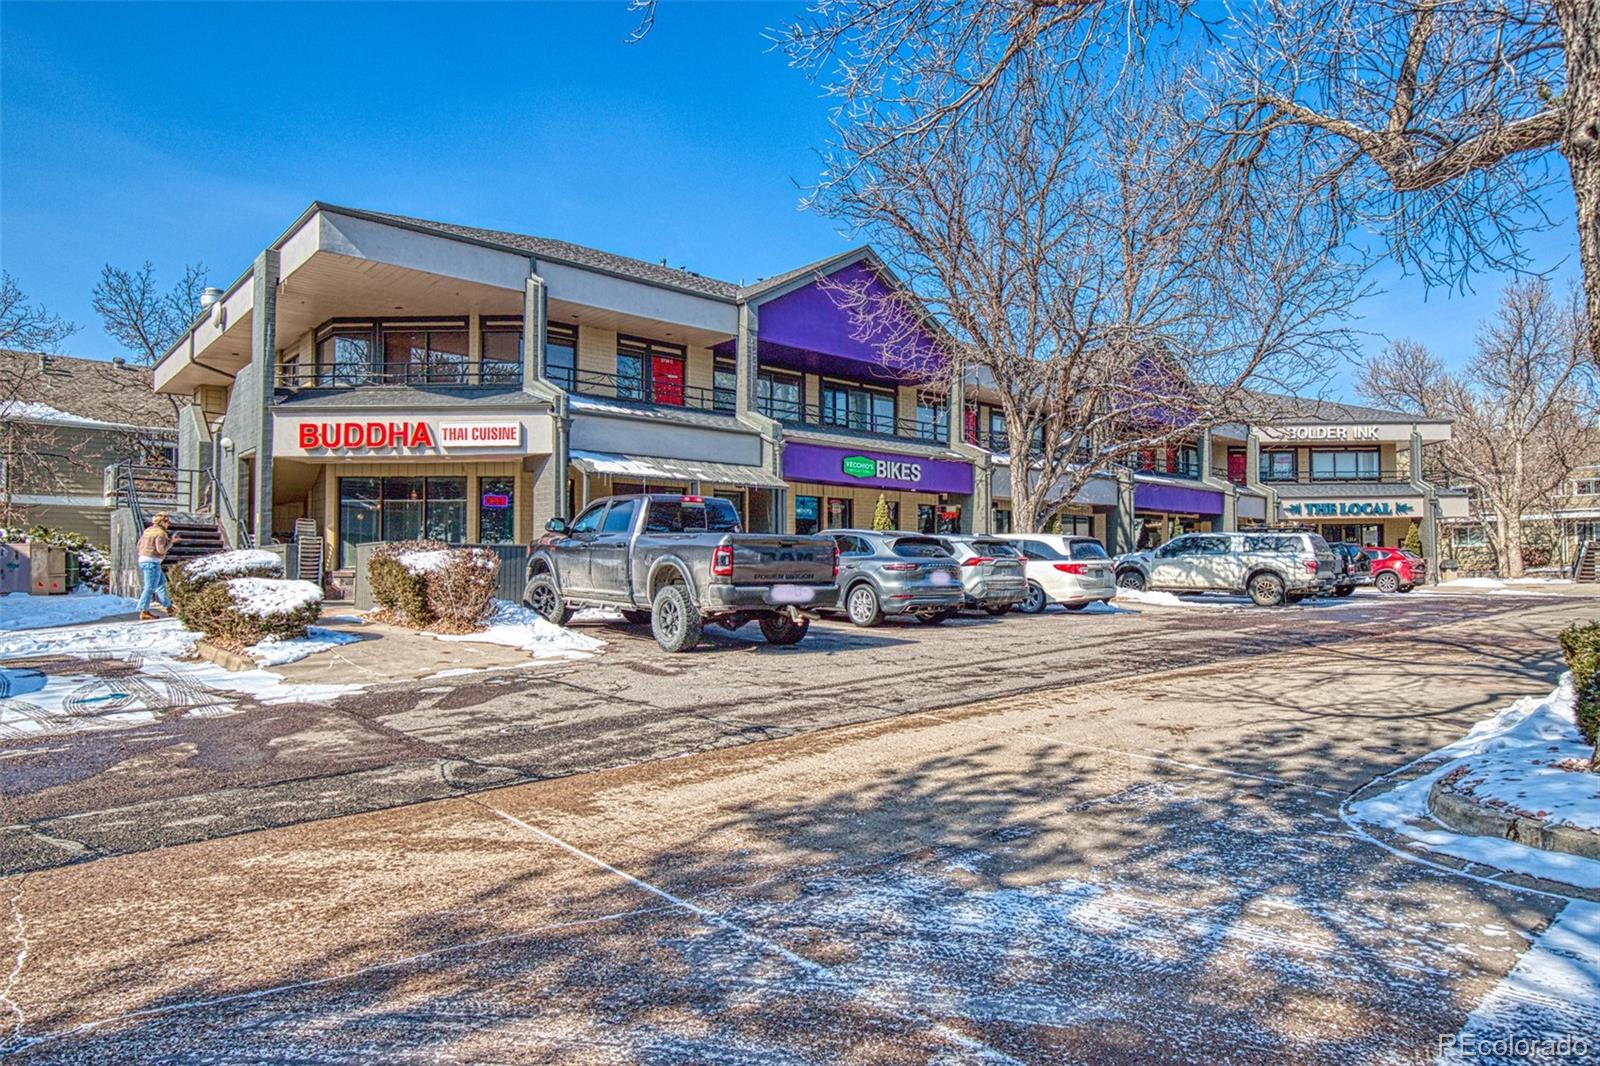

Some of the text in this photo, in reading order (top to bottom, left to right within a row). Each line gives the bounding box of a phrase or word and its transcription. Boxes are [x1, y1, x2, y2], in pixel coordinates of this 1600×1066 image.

[299, 422, 433, 448] BUDDHA
[441, 426, 517, 441] THAI CUISINE
[1353, 426, 1378, 439] INK
[876, 460, 921, 482] BIKES
[1303, 503, 1392, 515] THE LOCAL
[760, 552, 813, 562] RAM
